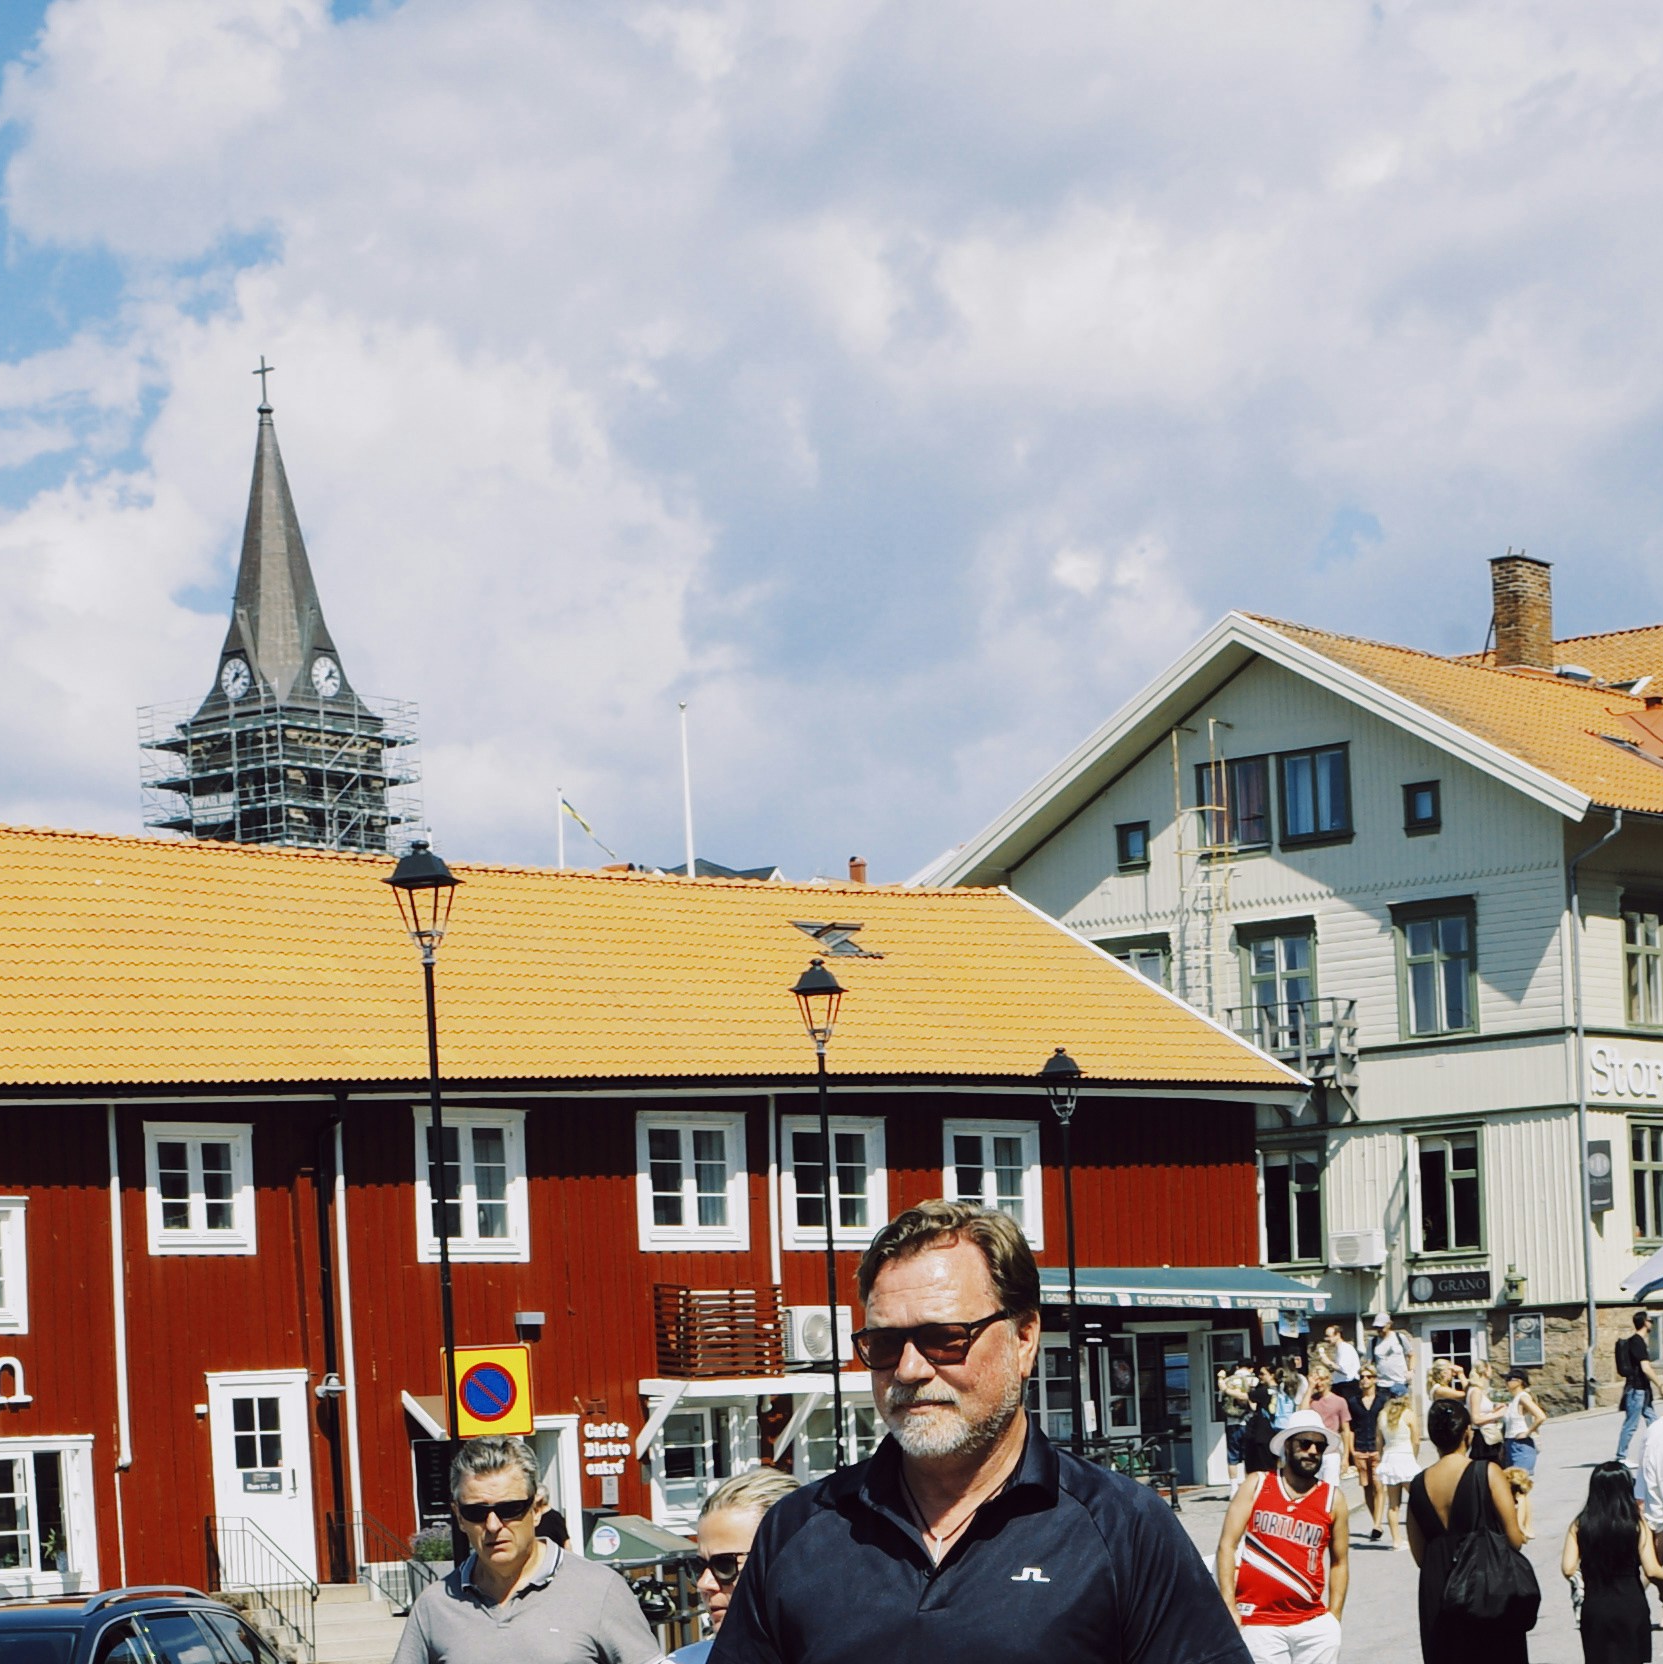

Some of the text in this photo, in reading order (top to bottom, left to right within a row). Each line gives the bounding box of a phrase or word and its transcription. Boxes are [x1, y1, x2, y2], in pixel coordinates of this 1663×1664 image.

[1438, 1278, 1487, 1293] GRANO
[584, 1422, 617, 1438] Café
[583, 1441, 631, 1457] Bistro
[1253, 1509, 1325, 1549] PORTLAND
